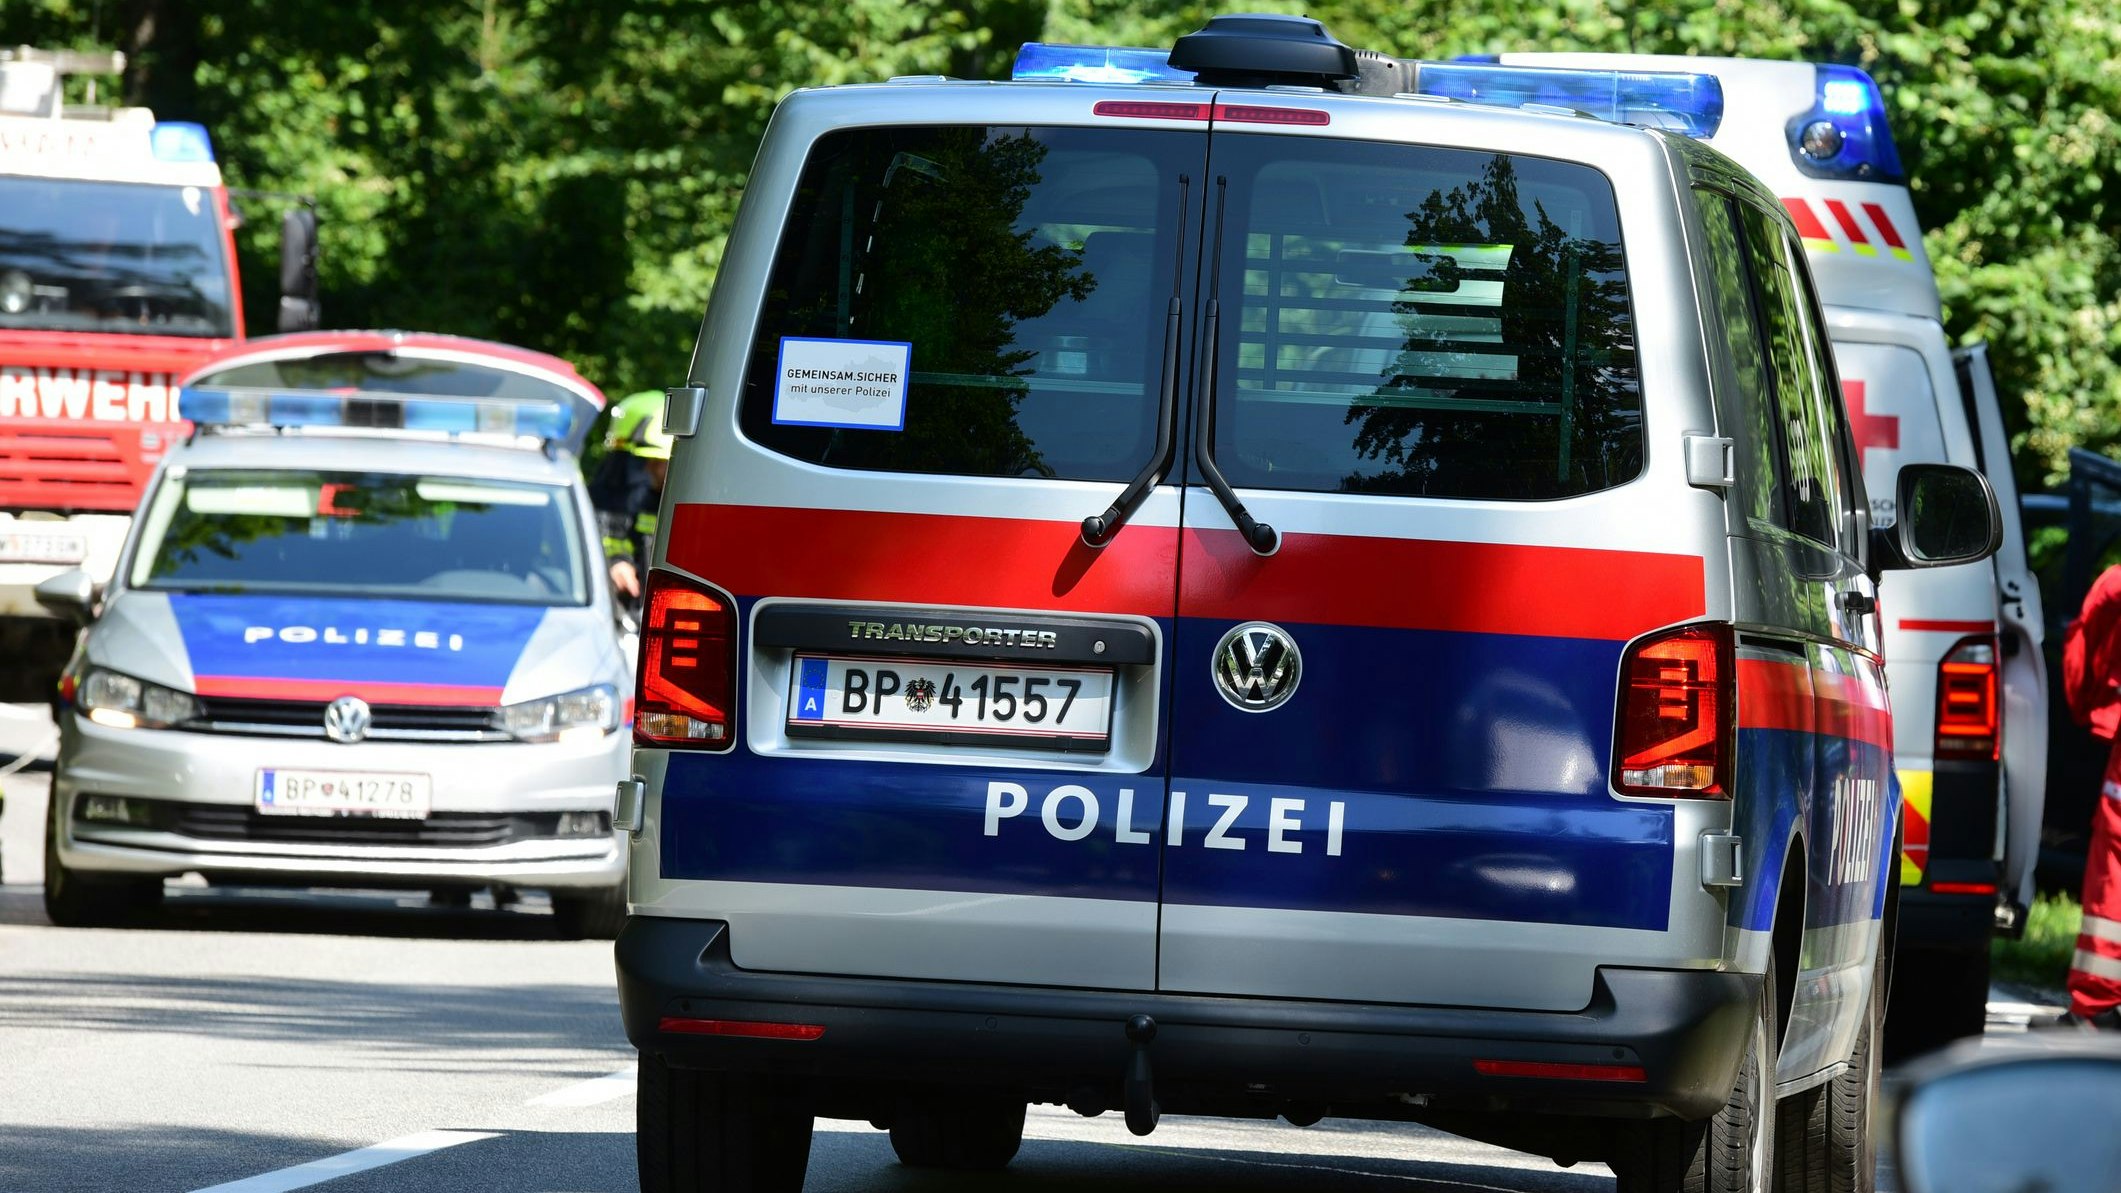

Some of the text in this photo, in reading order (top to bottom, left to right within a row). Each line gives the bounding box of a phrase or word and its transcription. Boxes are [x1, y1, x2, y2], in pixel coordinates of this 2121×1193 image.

[787, 368, 898, 383] GEMEINSAM.SICHER
[791, 384, 891, 398] mit unserer Polizei
[244, 626, 464, 652] POLIZEI
[848, 620, 1057, 649] TRANSPORTER
[803, 697, 818, 712] A
[842, 669, 1083, 725] BP 41557
[286, 777, 414, 804] BP 41278
[983, 781, 1346, 857] POLIZEI
[1827, 778, 1876, 887] POLIZEI
